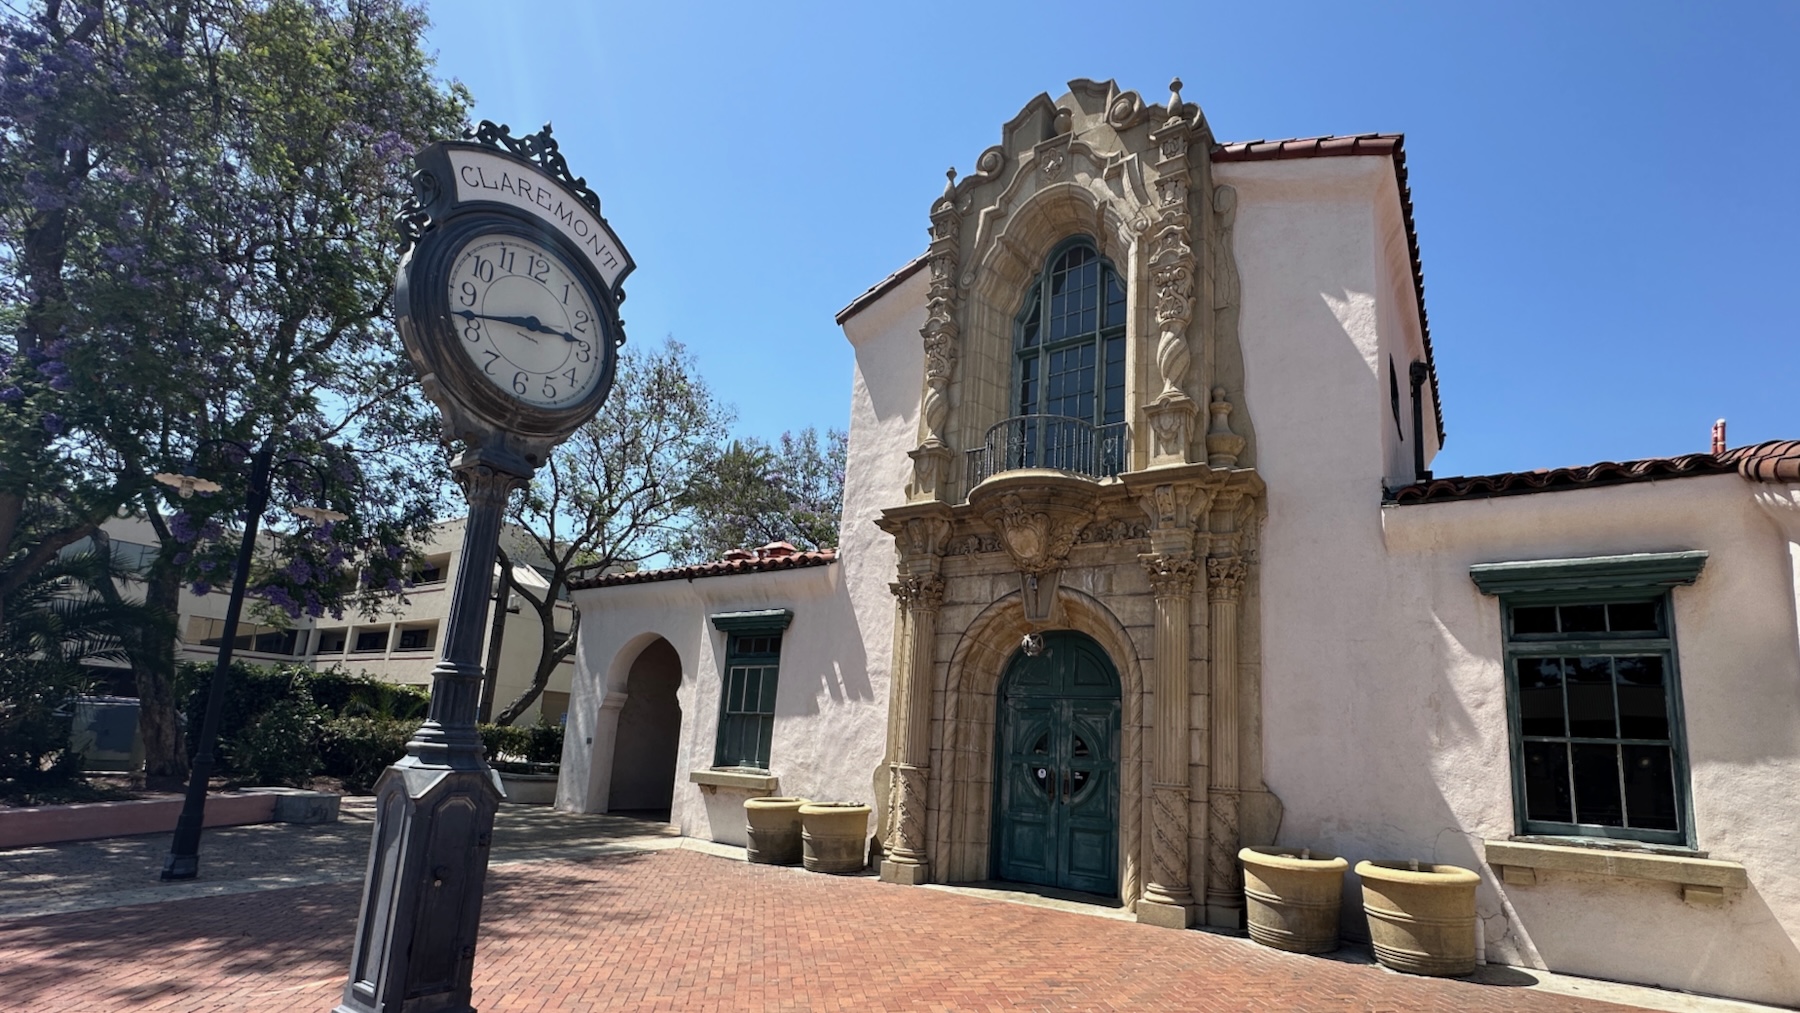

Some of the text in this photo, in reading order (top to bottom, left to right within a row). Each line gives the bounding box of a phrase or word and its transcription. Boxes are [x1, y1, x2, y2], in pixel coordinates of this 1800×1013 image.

[461, 165, 619, 271] CLAREMONT
[472, 255, 494, 283] 10
[498, 247, 514, 275] 11
[526, 255, 551, 284] 12
[460, 281, 477, 307] 9
[562, 284, 570, 306] 1
[464, 318, 481, 343] 8
[574, 310, 589, 334] 2
[482, 349, 501, 376] 7
[576, 340, 591, 363] 3
[513, 371, 529, 395] 6
[542, 375, 558, 399] 5
[562, 367, 579, 389] 4
